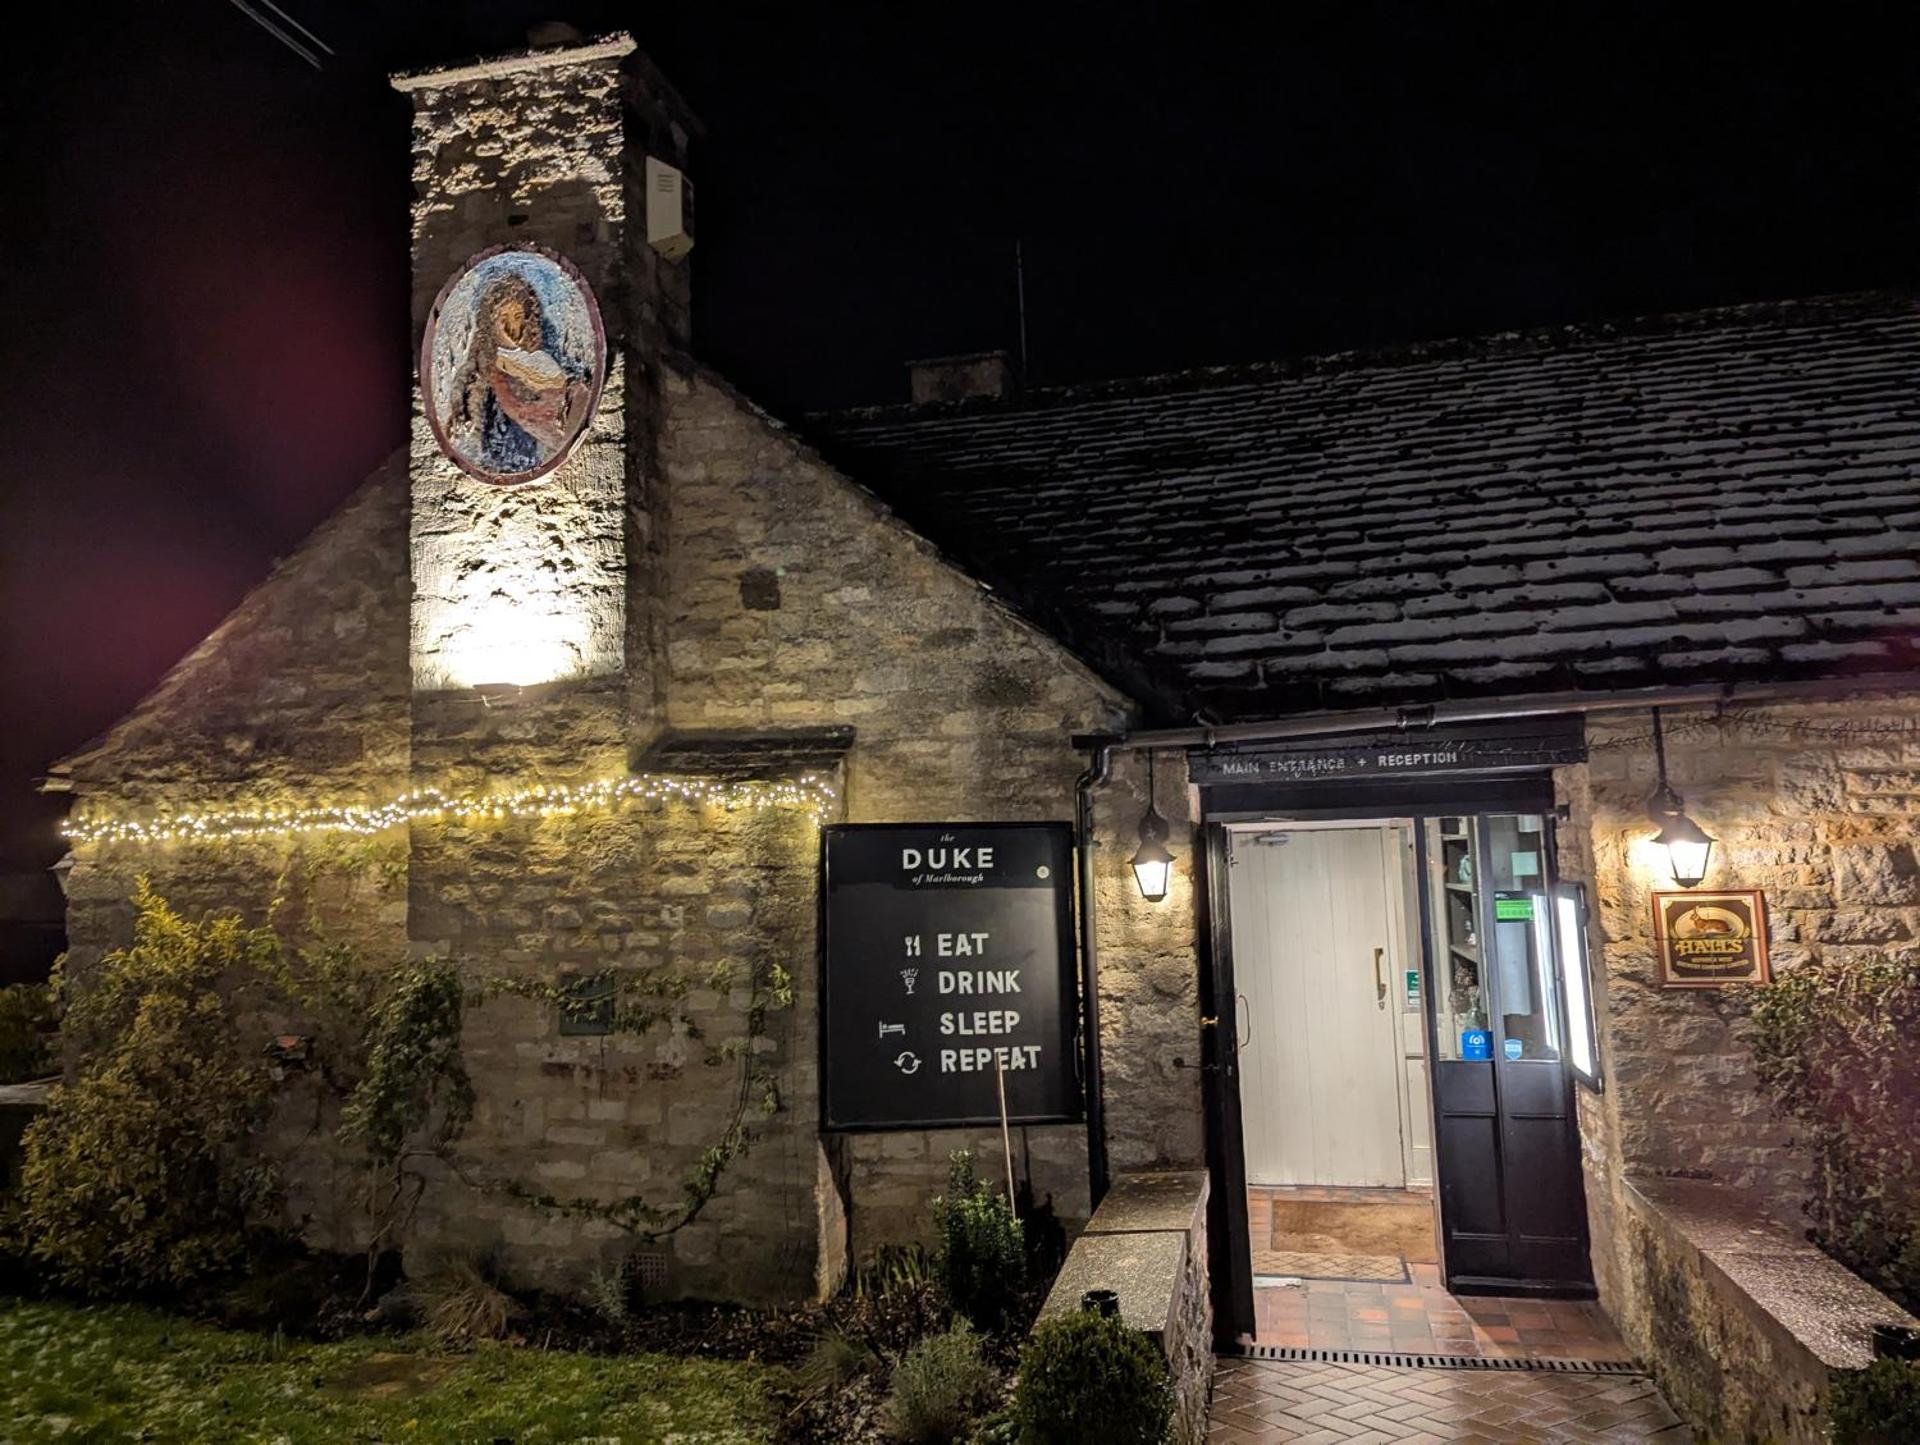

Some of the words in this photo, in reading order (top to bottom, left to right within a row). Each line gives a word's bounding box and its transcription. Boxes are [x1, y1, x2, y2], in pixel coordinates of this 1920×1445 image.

[1222, 762, 1260, 775] MAIN
[1269, 758, 1345, 772] ENTRANCE
[1378, 752, 1457, 767] RECEPTION
[940, 833, 956, 842] the
[902, 847, 994, 869] DUKE
[912, 874, 923, 885] of
[925, 873, 984, 884] Marlborough
[937, 933, 989, 957] EAT
[938, 970, 1021, 994] DRINK
[940, 1010, 1020, 1035] SLEEP
[941, 1045, 1042, 1073] REPEAT
